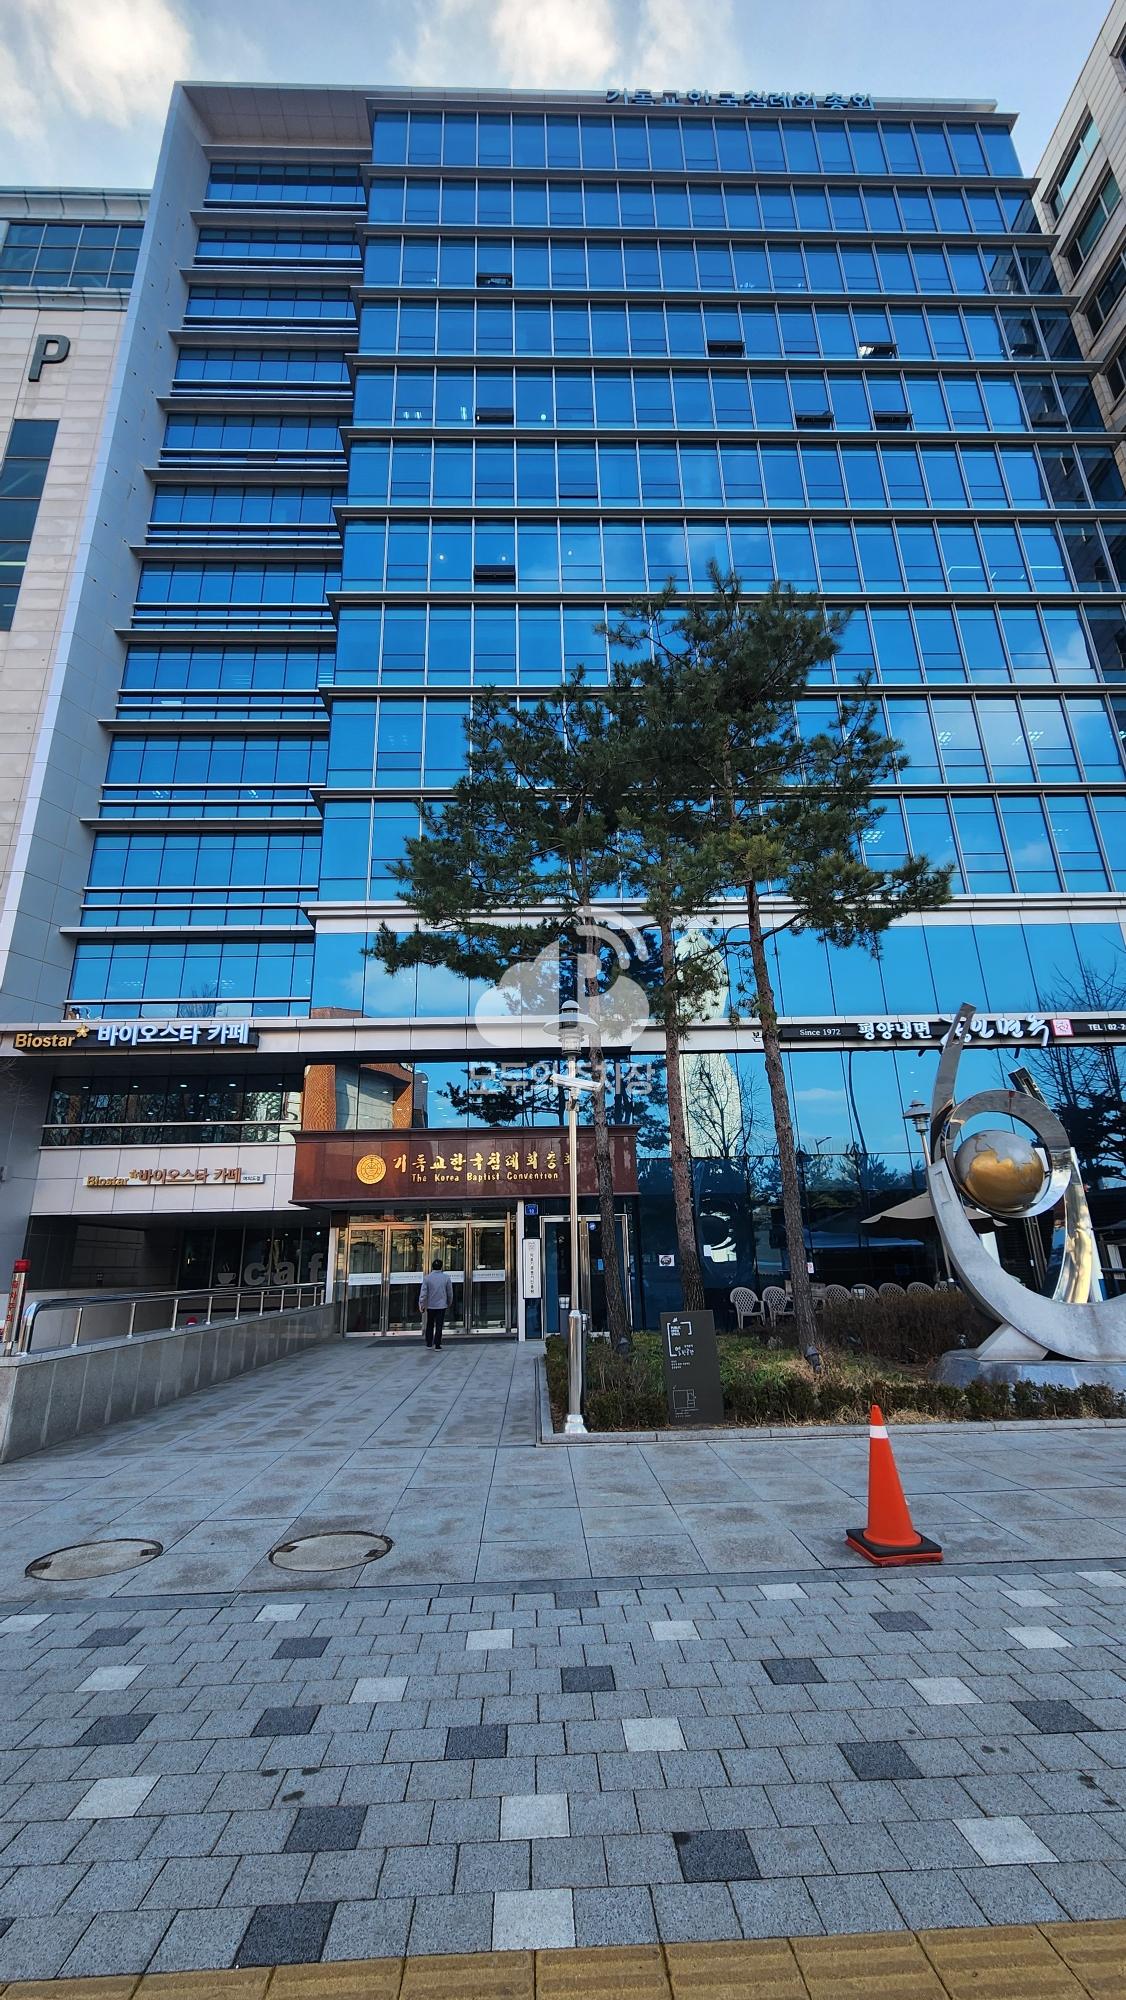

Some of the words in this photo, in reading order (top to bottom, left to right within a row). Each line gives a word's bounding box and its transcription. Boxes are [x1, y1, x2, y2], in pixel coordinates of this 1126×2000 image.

[28, 333, 71, 382] P
[97, 1024, 202, 1046] 바이오스타
[207, 1023, 250, 1044] 카페
[857, 1021, 932, 1040] 평양냉면
[15, 1033, 76, 1049] Biostar
[87, 1175, 129, 1187] Biostar
[138, 1169, 209, 1185] 바이오스타
[213, 1168, 242, 1183] 카페
[412, 1173, 427, 1182] The
[434, 1173, 460, 1182] Korea
[466, 1172, 500, 1182] Baptist
[506, 1171, 559, 1181] Convention
